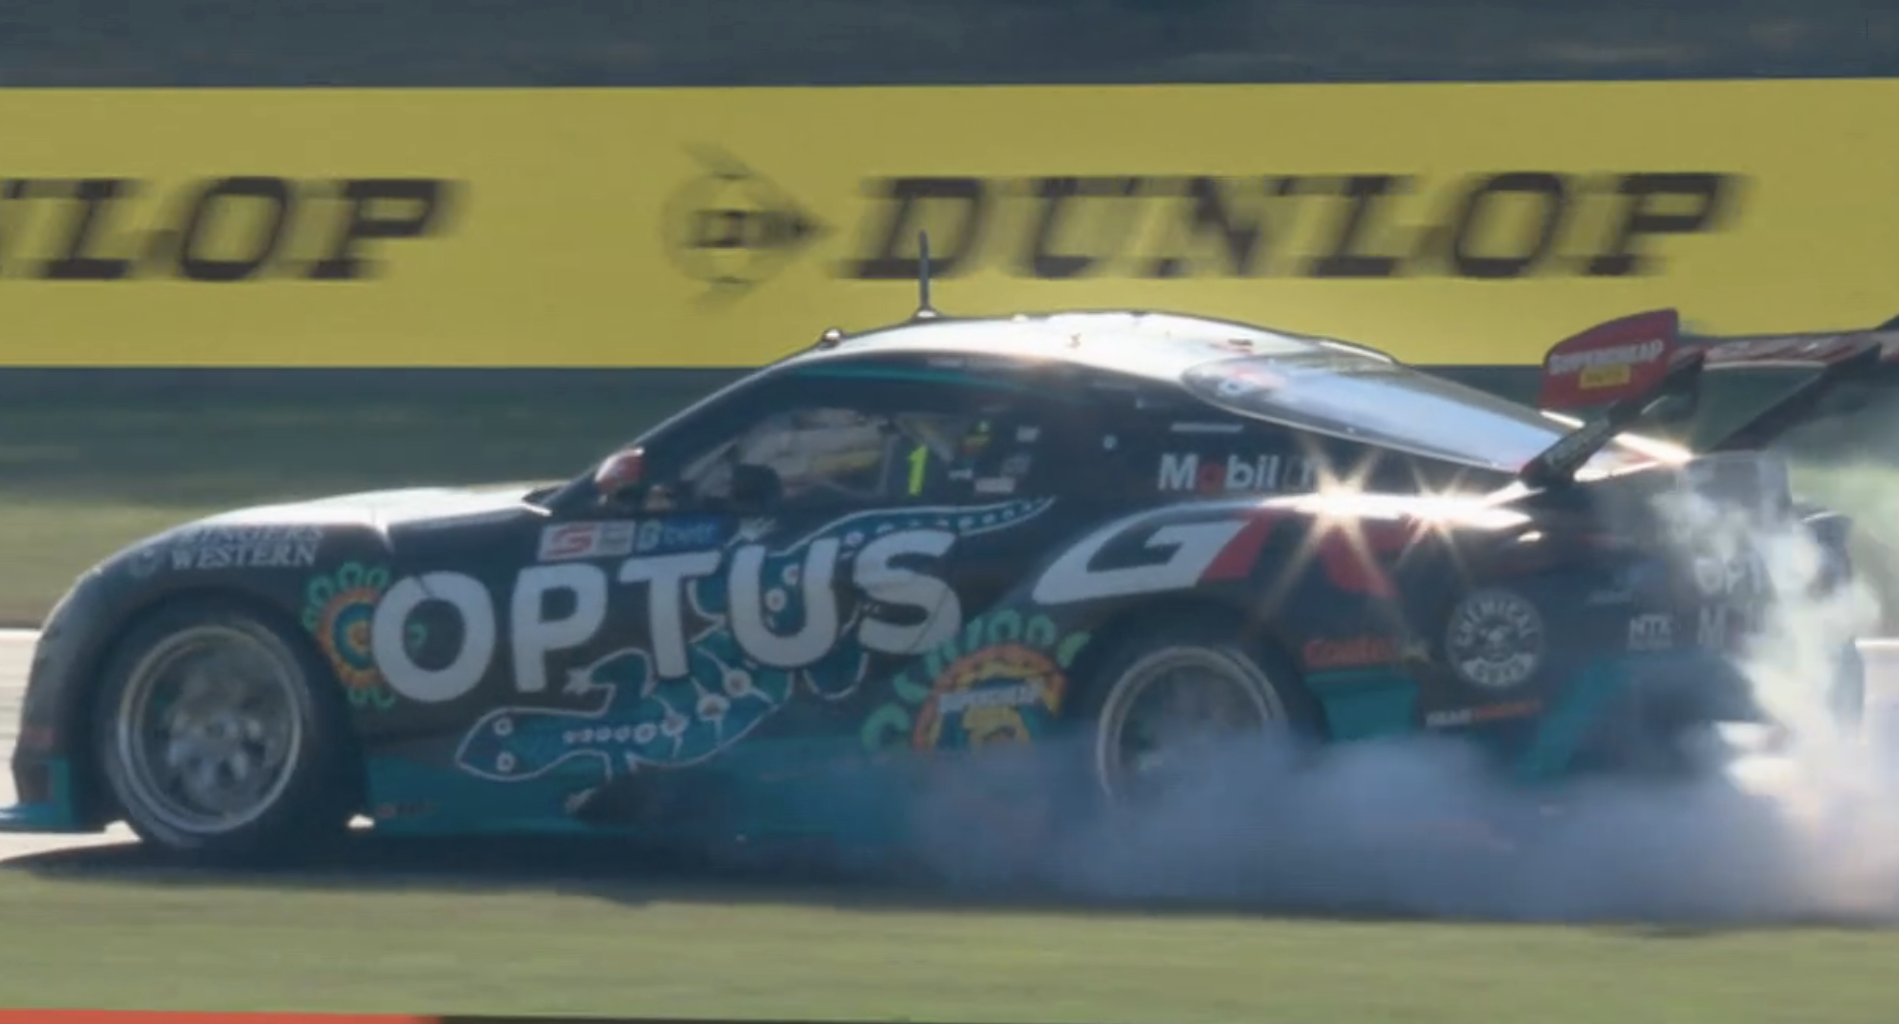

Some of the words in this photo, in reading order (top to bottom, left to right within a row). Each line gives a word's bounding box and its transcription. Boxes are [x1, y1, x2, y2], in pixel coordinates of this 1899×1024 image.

[0, 176, 460, 281] LOP
[845, 170, 1748, 280] DUNLOP
[908, 444, 928, 495] 1
[1158, 453, 1279, 493] Mobil
[171, 539, 319, 571] WESTERN
[372, 529, 962, 702] OPTUS
